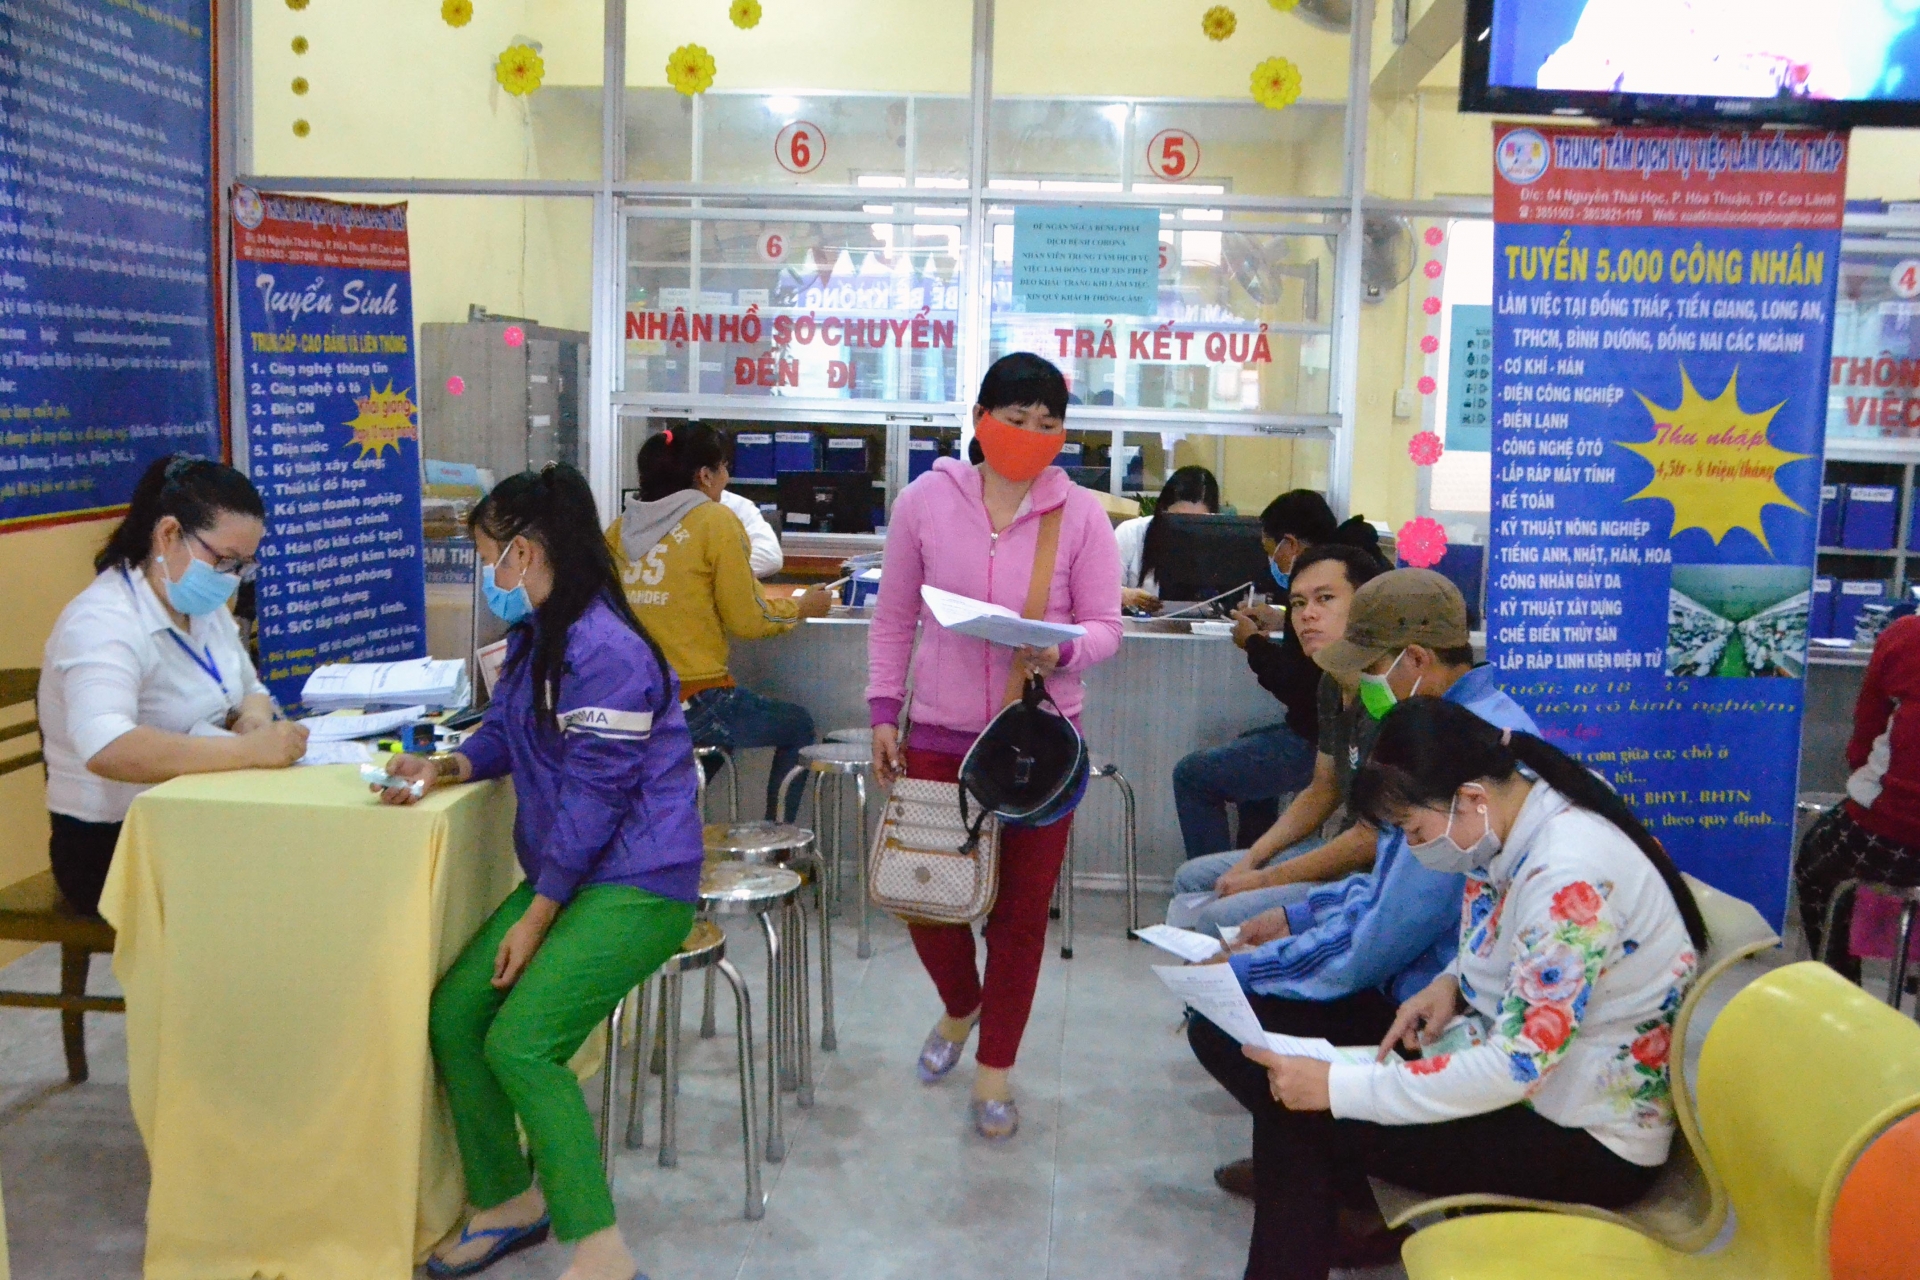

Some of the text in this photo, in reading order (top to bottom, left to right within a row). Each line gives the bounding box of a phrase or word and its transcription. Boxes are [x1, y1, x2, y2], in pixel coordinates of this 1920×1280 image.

[790, 130, 811, 168] 6
[1162, 137, 1186, 176] 5
[1554, 135, 1602, 169] TRUNG
[766, 235, 782, 258] 6
[1505, 229, 1825, 286] TUYỂN 5.000 CÔNG NHÂN
[1899, 266, 1917, 291] 4
[255, 274, 334, 322] Tuyển
[340, 279, 399, 316] Sinh
[1498, 290, 1527, 315] LÀM
[1531, 290, 1561, 319] VIỆC
[1564, 296, 1587, 320] TẠI
[1590, 289, 1629, 317] ĐỒNG
[1761, 300, 1798, 320] LONG
[625, 303, 954, 349] NHẬN HỒ SƠ CHUYỂN
[1513, 328, 1563, 352] TPHCM,
[1566, 325, 1600, 349] BÌNH
[1700, 332, 1723, 351] NAI
[1726, 327, 1755, 351] CÁC
[1757, 328, 1805, 352] NGÀNH
[1054, 319, 1273, 364] TRẢ KẾT QUẢ
[734, 347, 857, 389] ĐẾN ĐI
[1525, 355, 1548, 374] KHÍ
[1503, 382, 1624, 407] ĐIỆN CÔNG NGHIỆP
[296, 402, 315, 414] CN
[1503, 409, 1569, 434] ĐIỆN LẠNH
[1652, 422, 1698, 446] Thu
[1502, 436, 1536, 455] CÔNG
[1539, 436, 1574, 460] NGHỆ
[1502, 460, 1615, 483] LẮP RÁP MÁY TÍNH
[1501, 489, 1554, 509] KẾ TOÁN
[1521, 517, 1562, 540] THUẬT
[1565, 516, 1598, 536] NÔNG
[1601, 518, 1650, 541] NGHIỆP
[1501, 541, 1538, 563] TIẾNG
[1645, 549, 1672, 563] HOA
[1500, 570, 1536, 589] CÔNG
[1539, 570, 1574, 589] NHÂN
[1604, 574, 1621, 589] DA
[1521, 597, 1563, 619] THUẬT
[1567, 597, 1588, 615] XÂY
[1591, 598, 1622, 619] DỰNG
[1500, 621, 1526, 643] CHẾ
[1529, 620, 1560, 642] BIẾN
[1526, 650, 1553, 670] RÁP
[1556, 652, 1584, 669] LINH
[1587, 649, 1611, 672] KIỆN
[1614, 649, 1642, 672] ĐIỆN
